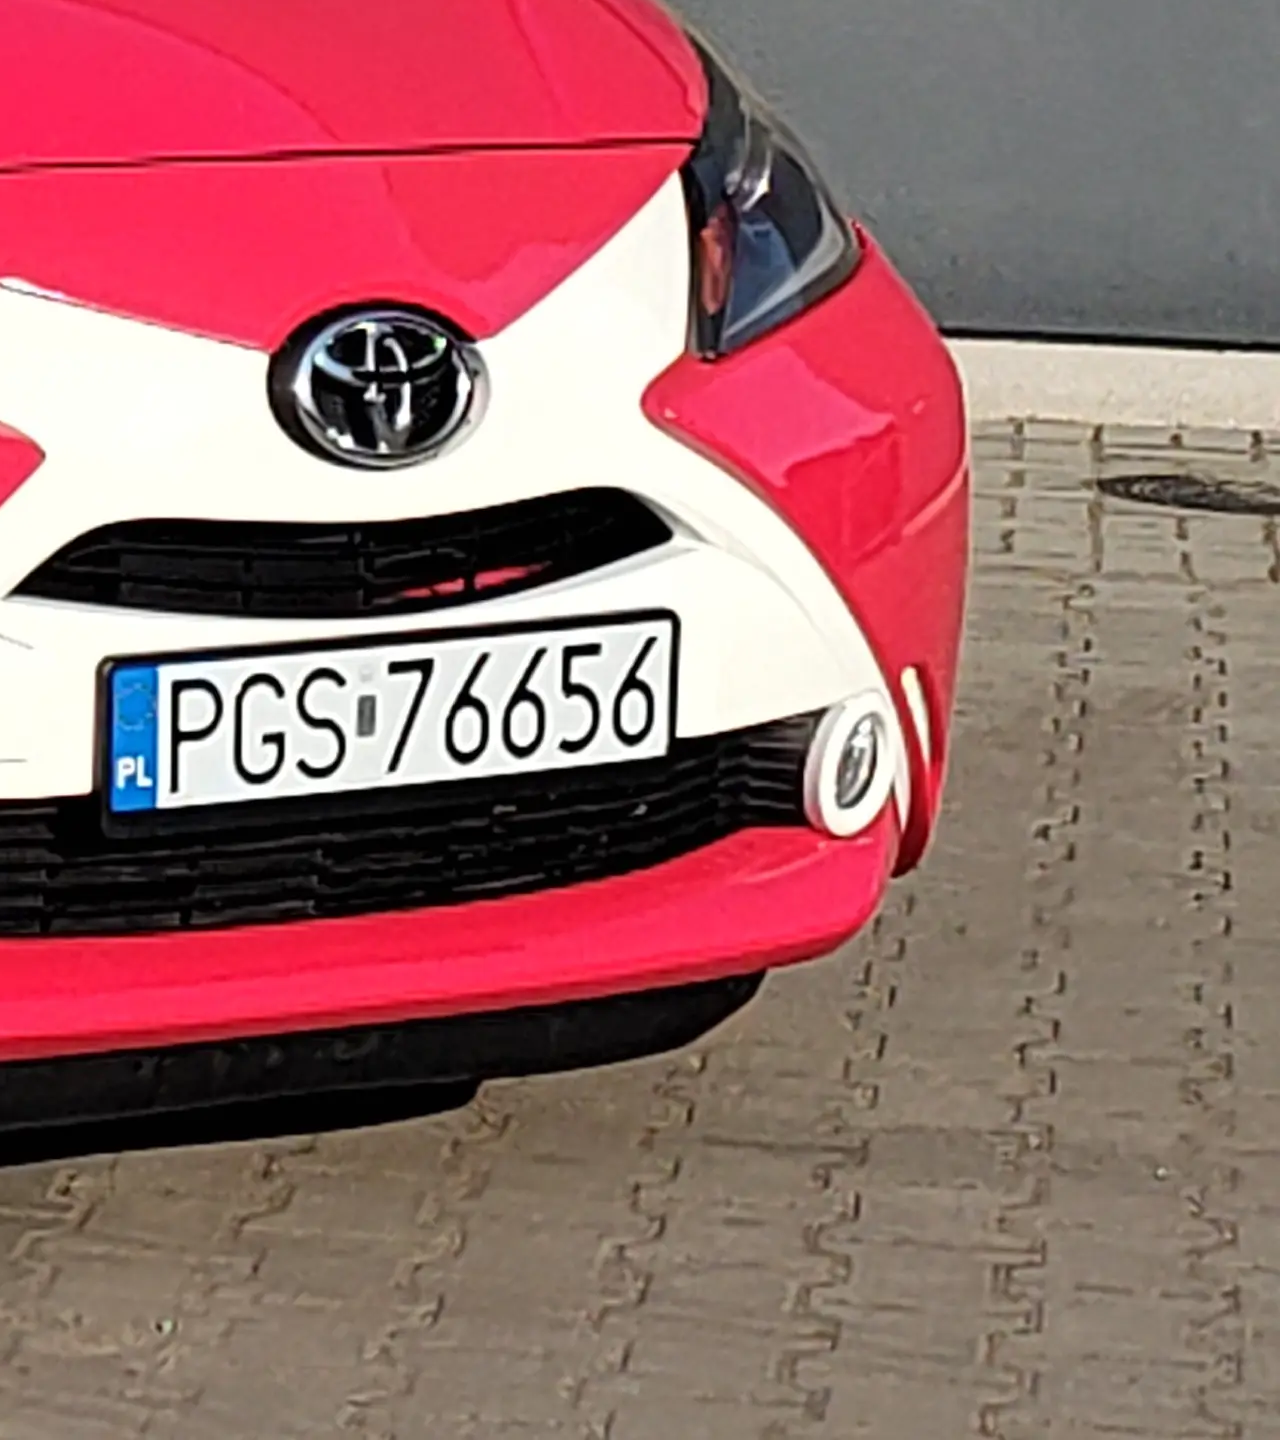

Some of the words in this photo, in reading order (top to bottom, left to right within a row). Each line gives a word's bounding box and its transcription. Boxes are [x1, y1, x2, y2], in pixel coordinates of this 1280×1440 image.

[170, 668, 347, 793] PGS
[387, 636, 658, 773] 76656
[117, 757, 152, 789] PL
